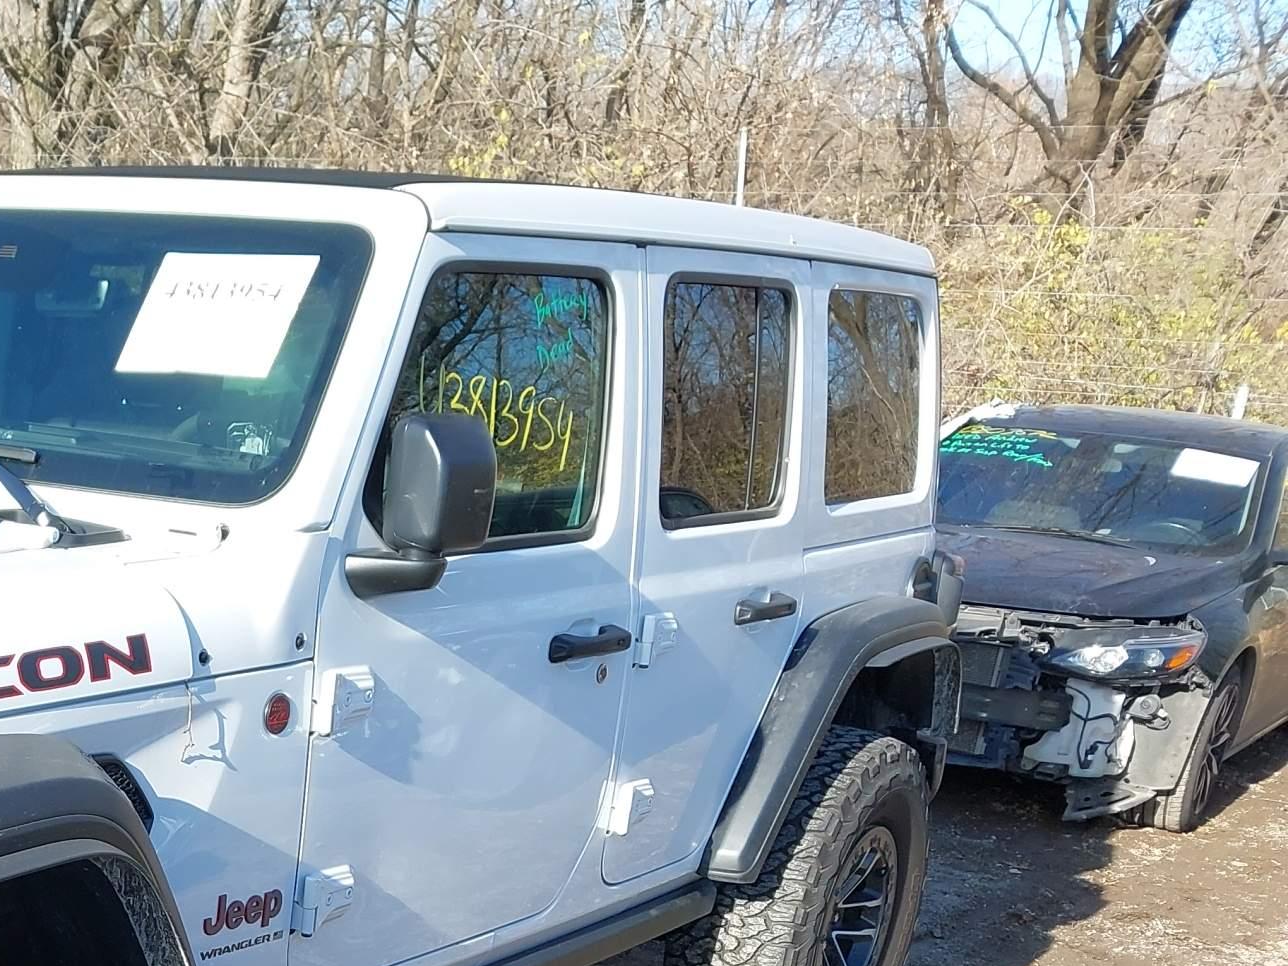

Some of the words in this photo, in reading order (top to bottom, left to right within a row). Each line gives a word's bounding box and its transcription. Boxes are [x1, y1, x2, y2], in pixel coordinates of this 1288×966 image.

[536, 327, 574, 372] Dead
[203, 889, 283, 936] Jeep
[199, 933, 271, 961] WRANGLER
